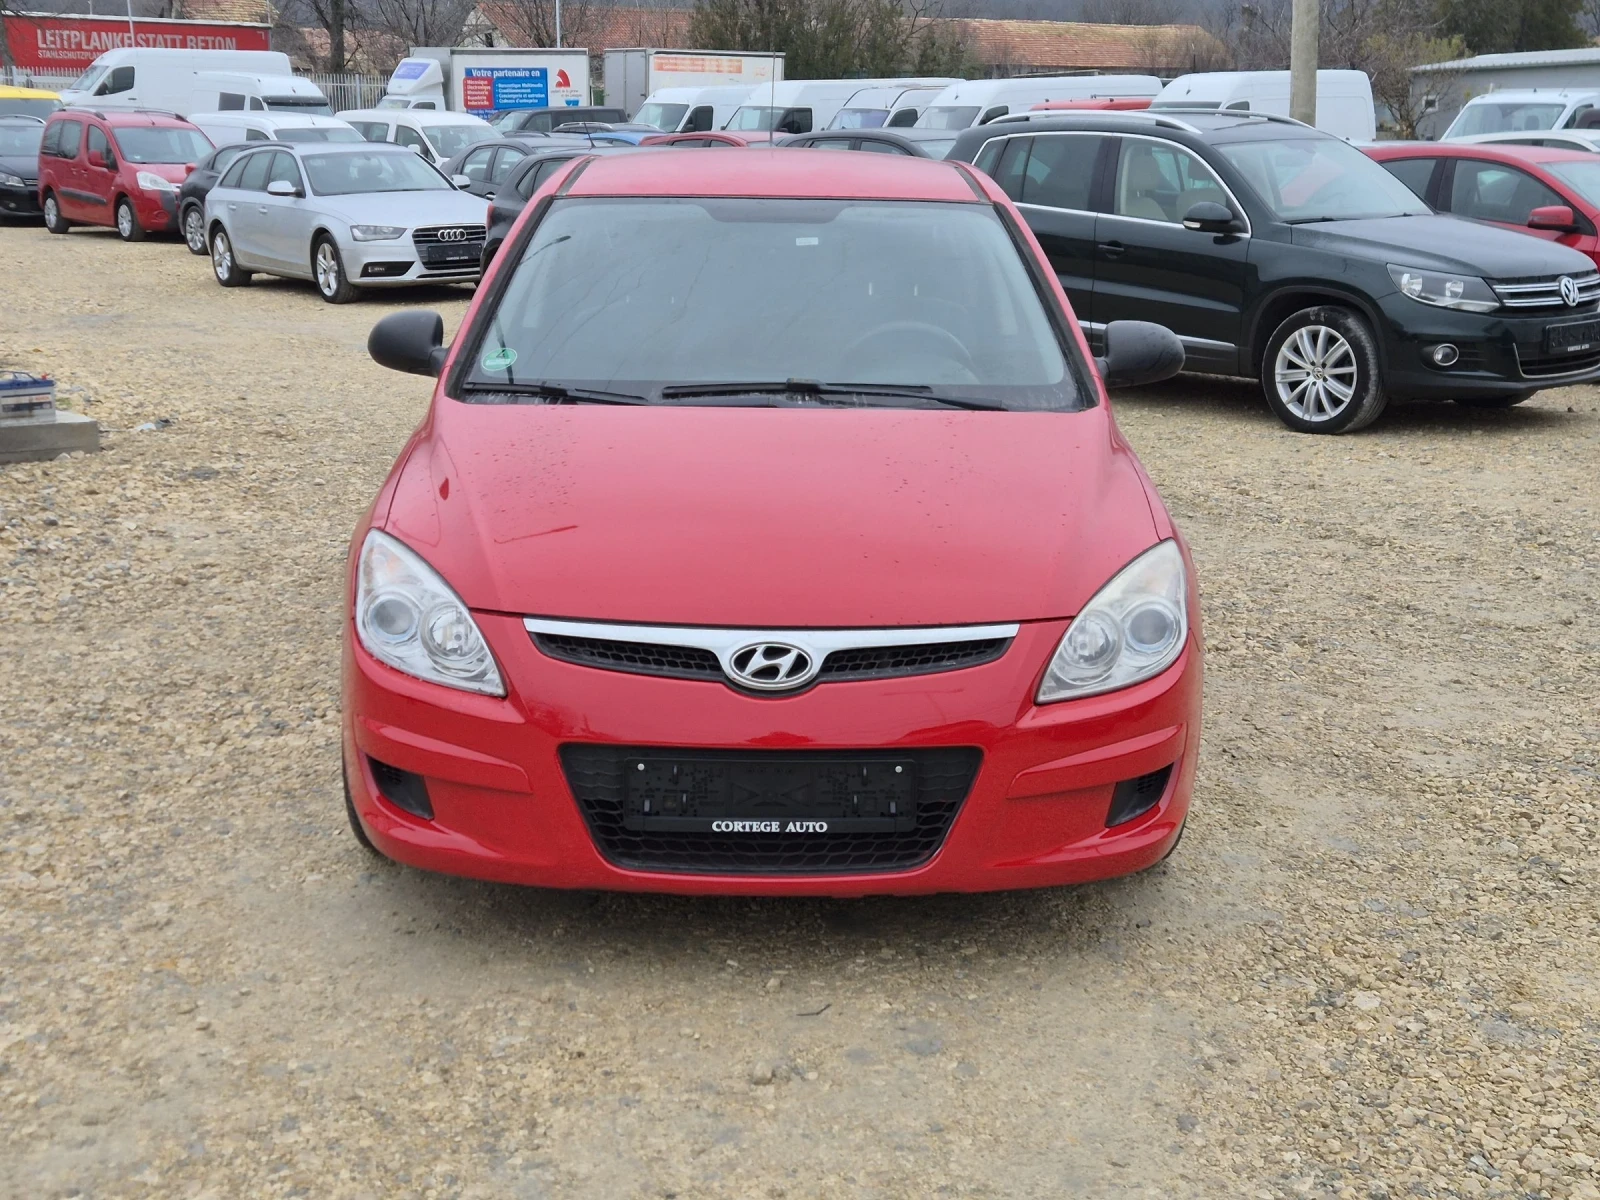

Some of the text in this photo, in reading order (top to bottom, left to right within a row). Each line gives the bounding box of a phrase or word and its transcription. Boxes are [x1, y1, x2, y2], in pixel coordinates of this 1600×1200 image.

[36, 29, 236, 50] LEITPLANKE STATT BETON
[471, 69, 492, 77] Votre
[493, 69, 530, 79] partenaire
[712, 821, 828, 832] CORTEGE AUTO
